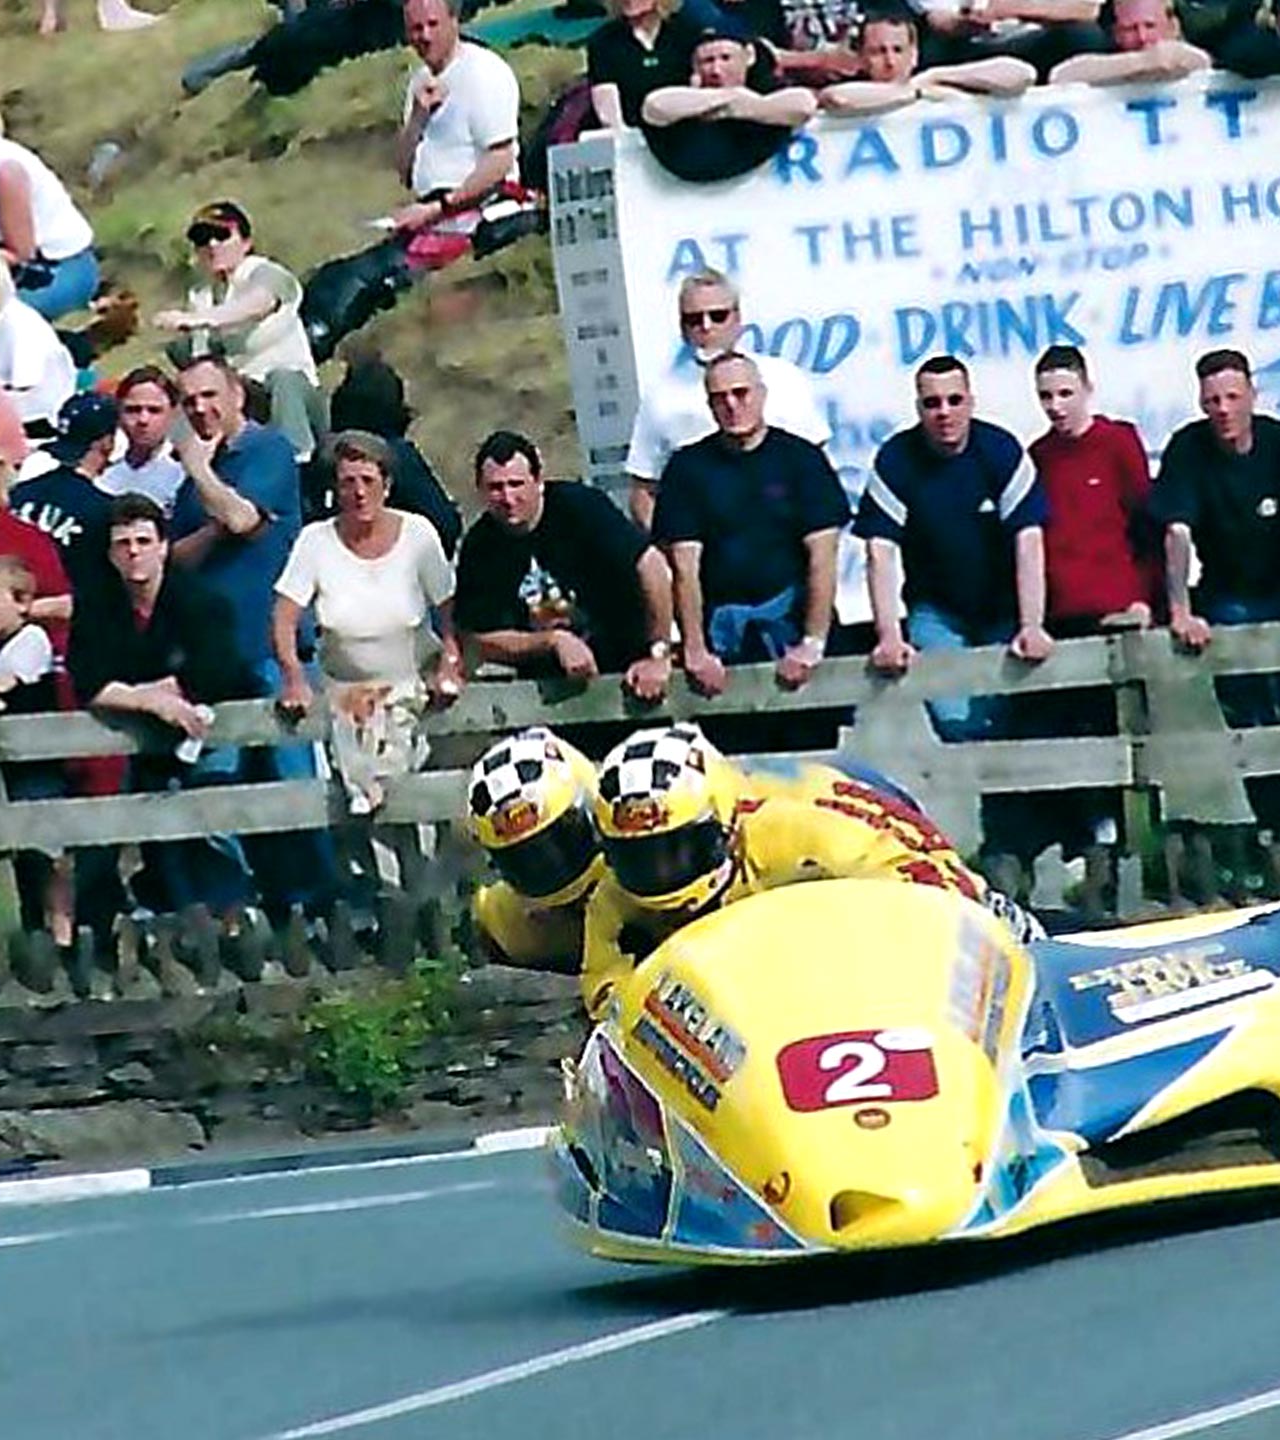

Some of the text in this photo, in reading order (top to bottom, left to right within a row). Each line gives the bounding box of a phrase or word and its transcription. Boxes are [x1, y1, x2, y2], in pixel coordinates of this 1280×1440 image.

[772, 107, 1081, 183] RADIO
[668, 233, 749, 281] AT
[793, 214, 922, 266] THE
[960, 187, 1195, 250] HILTON
[894, 290, 1087, 365] DRINK
[1118, 271, 1247, 346] LIVE
[818, 1038, 894, 1104] 2
